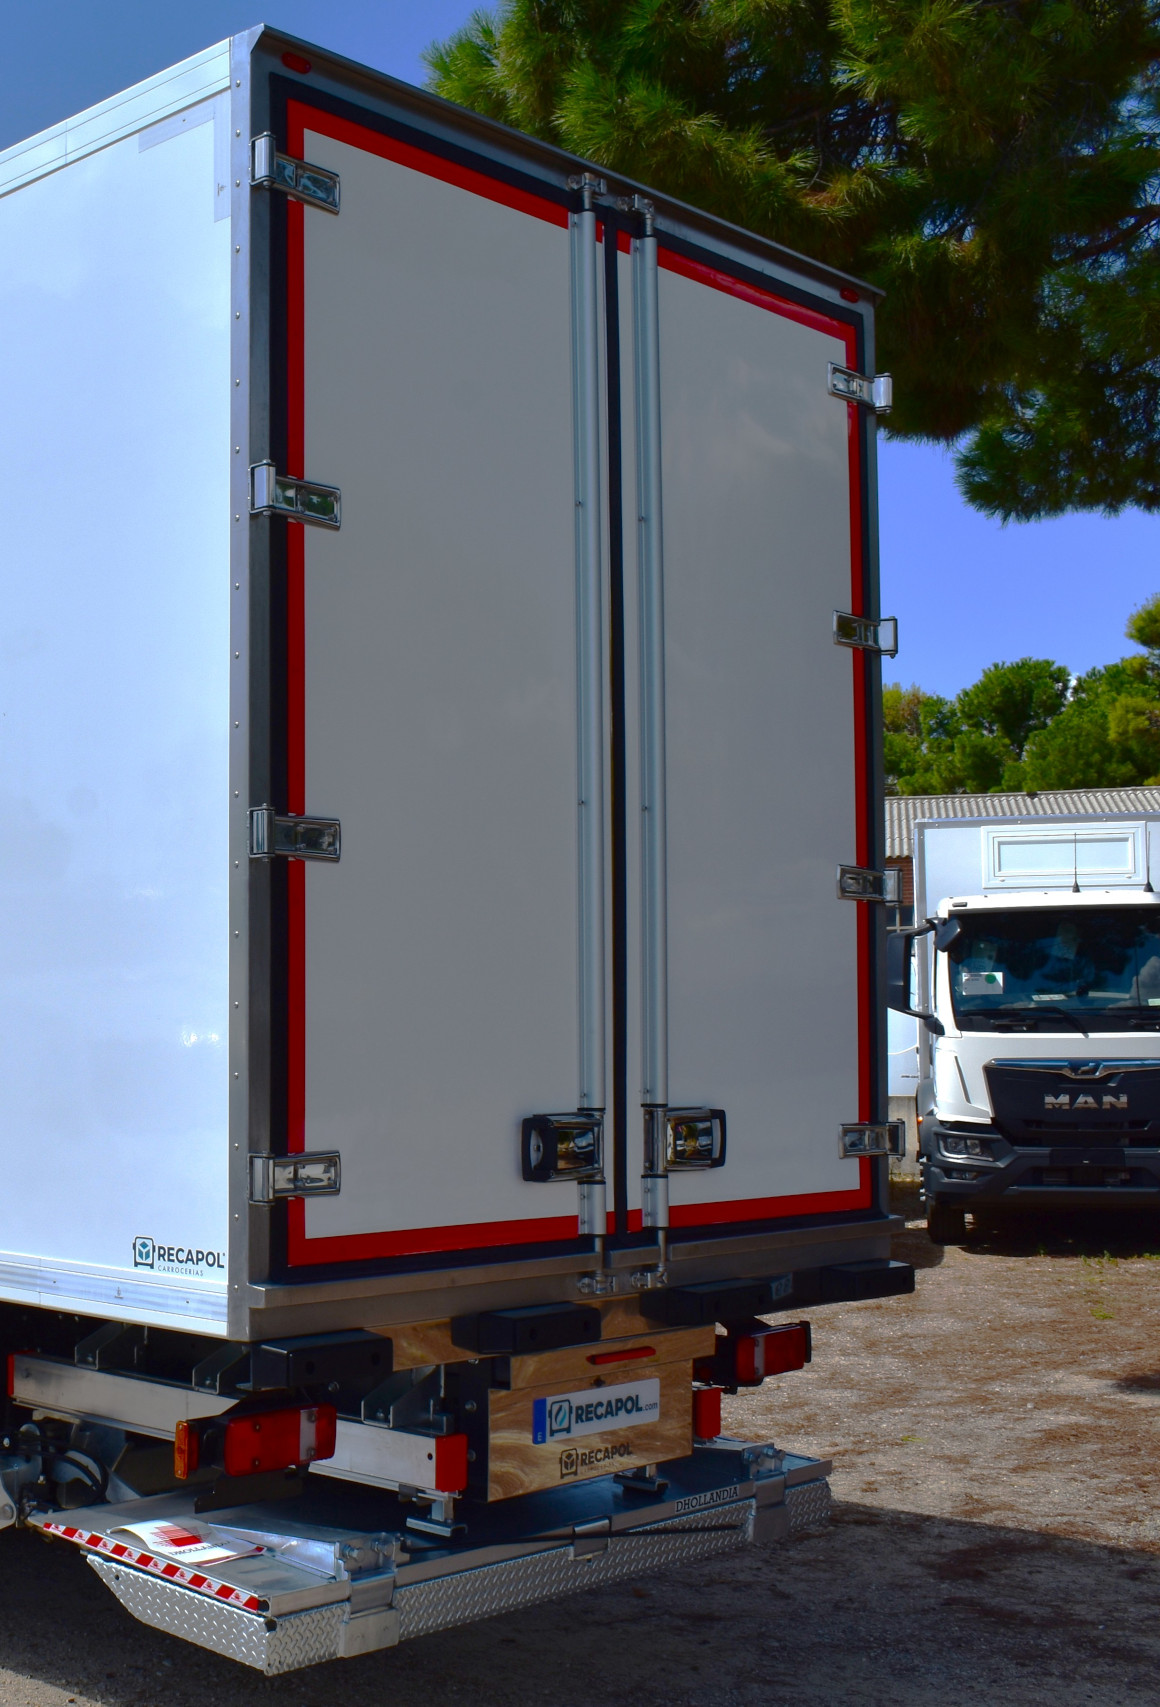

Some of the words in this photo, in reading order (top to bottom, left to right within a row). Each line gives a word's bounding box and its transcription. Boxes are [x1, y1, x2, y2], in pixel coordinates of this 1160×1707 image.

[1044, 1094, 1128, 1110] MAN
[157, 1245, 225, 1269] RECAPOL
[580, 1441, 633, 1467] RECAPOL
[675, 1486, 738, 1512] DHOLLANDIA
